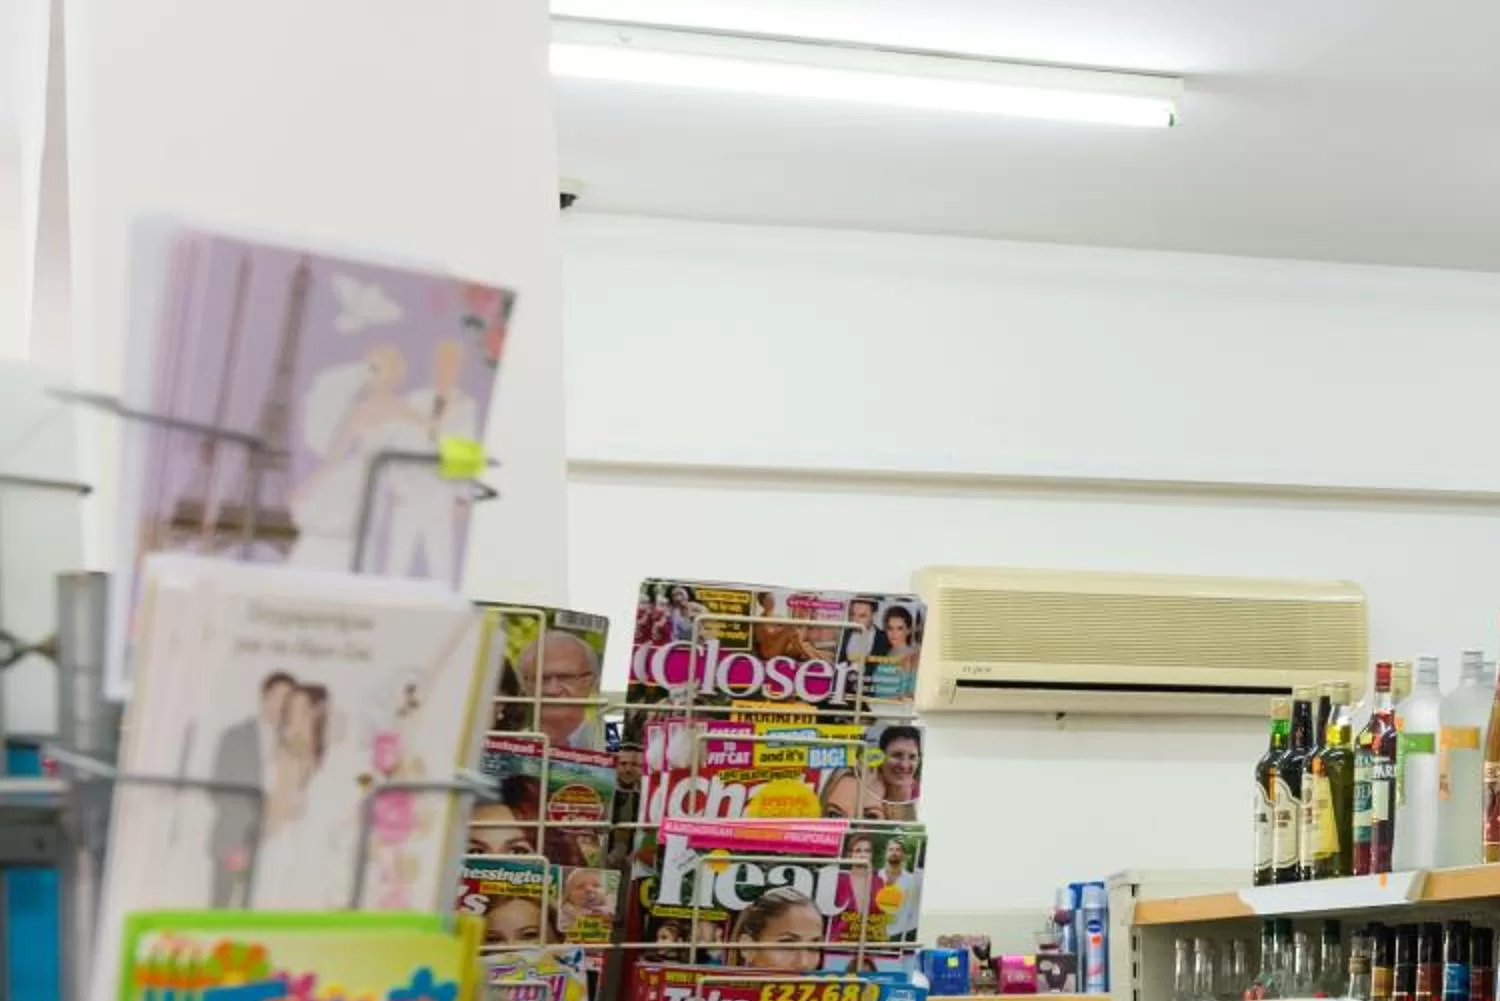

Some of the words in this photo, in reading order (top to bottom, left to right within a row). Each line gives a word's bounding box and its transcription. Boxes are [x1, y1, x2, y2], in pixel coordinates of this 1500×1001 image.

[652, 639, 853, 705] Closer
[760, 750, 784, 763] and
[657, 834, 851, 917] heat
